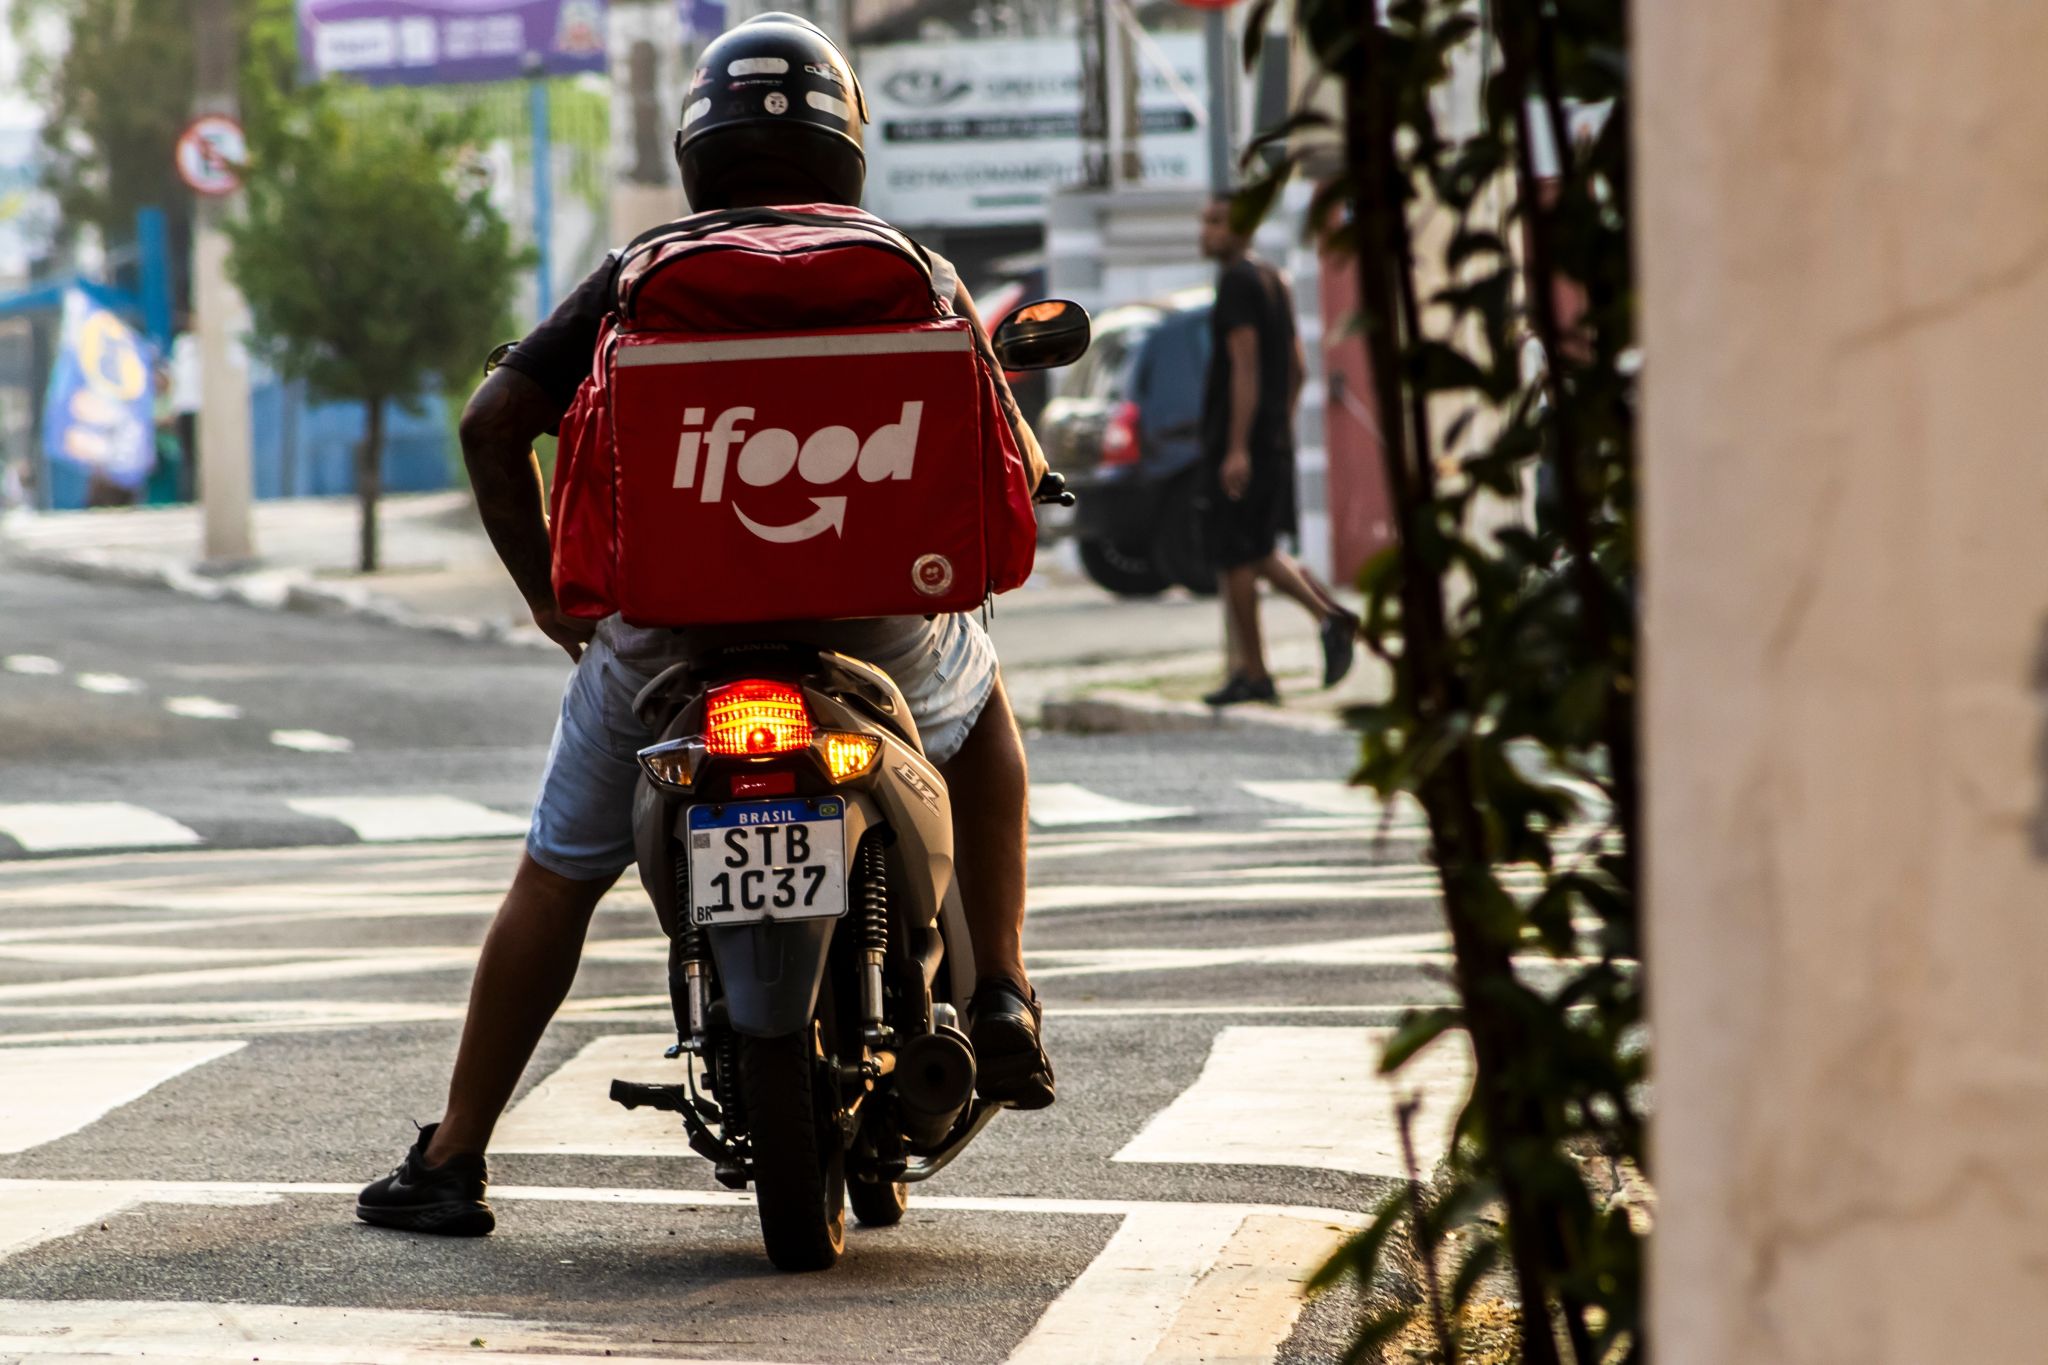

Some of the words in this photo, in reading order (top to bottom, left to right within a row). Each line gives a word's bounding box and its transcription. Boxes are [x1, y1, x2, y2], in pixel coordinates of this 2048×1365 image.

[672, 400, 924, 503] ifood
[738, 809, 797, 825] BRASIL
[724, 823, 811, 869] STB
[710, 865, 827, 913] 1C37
[696, 905, 714, 922] BR
